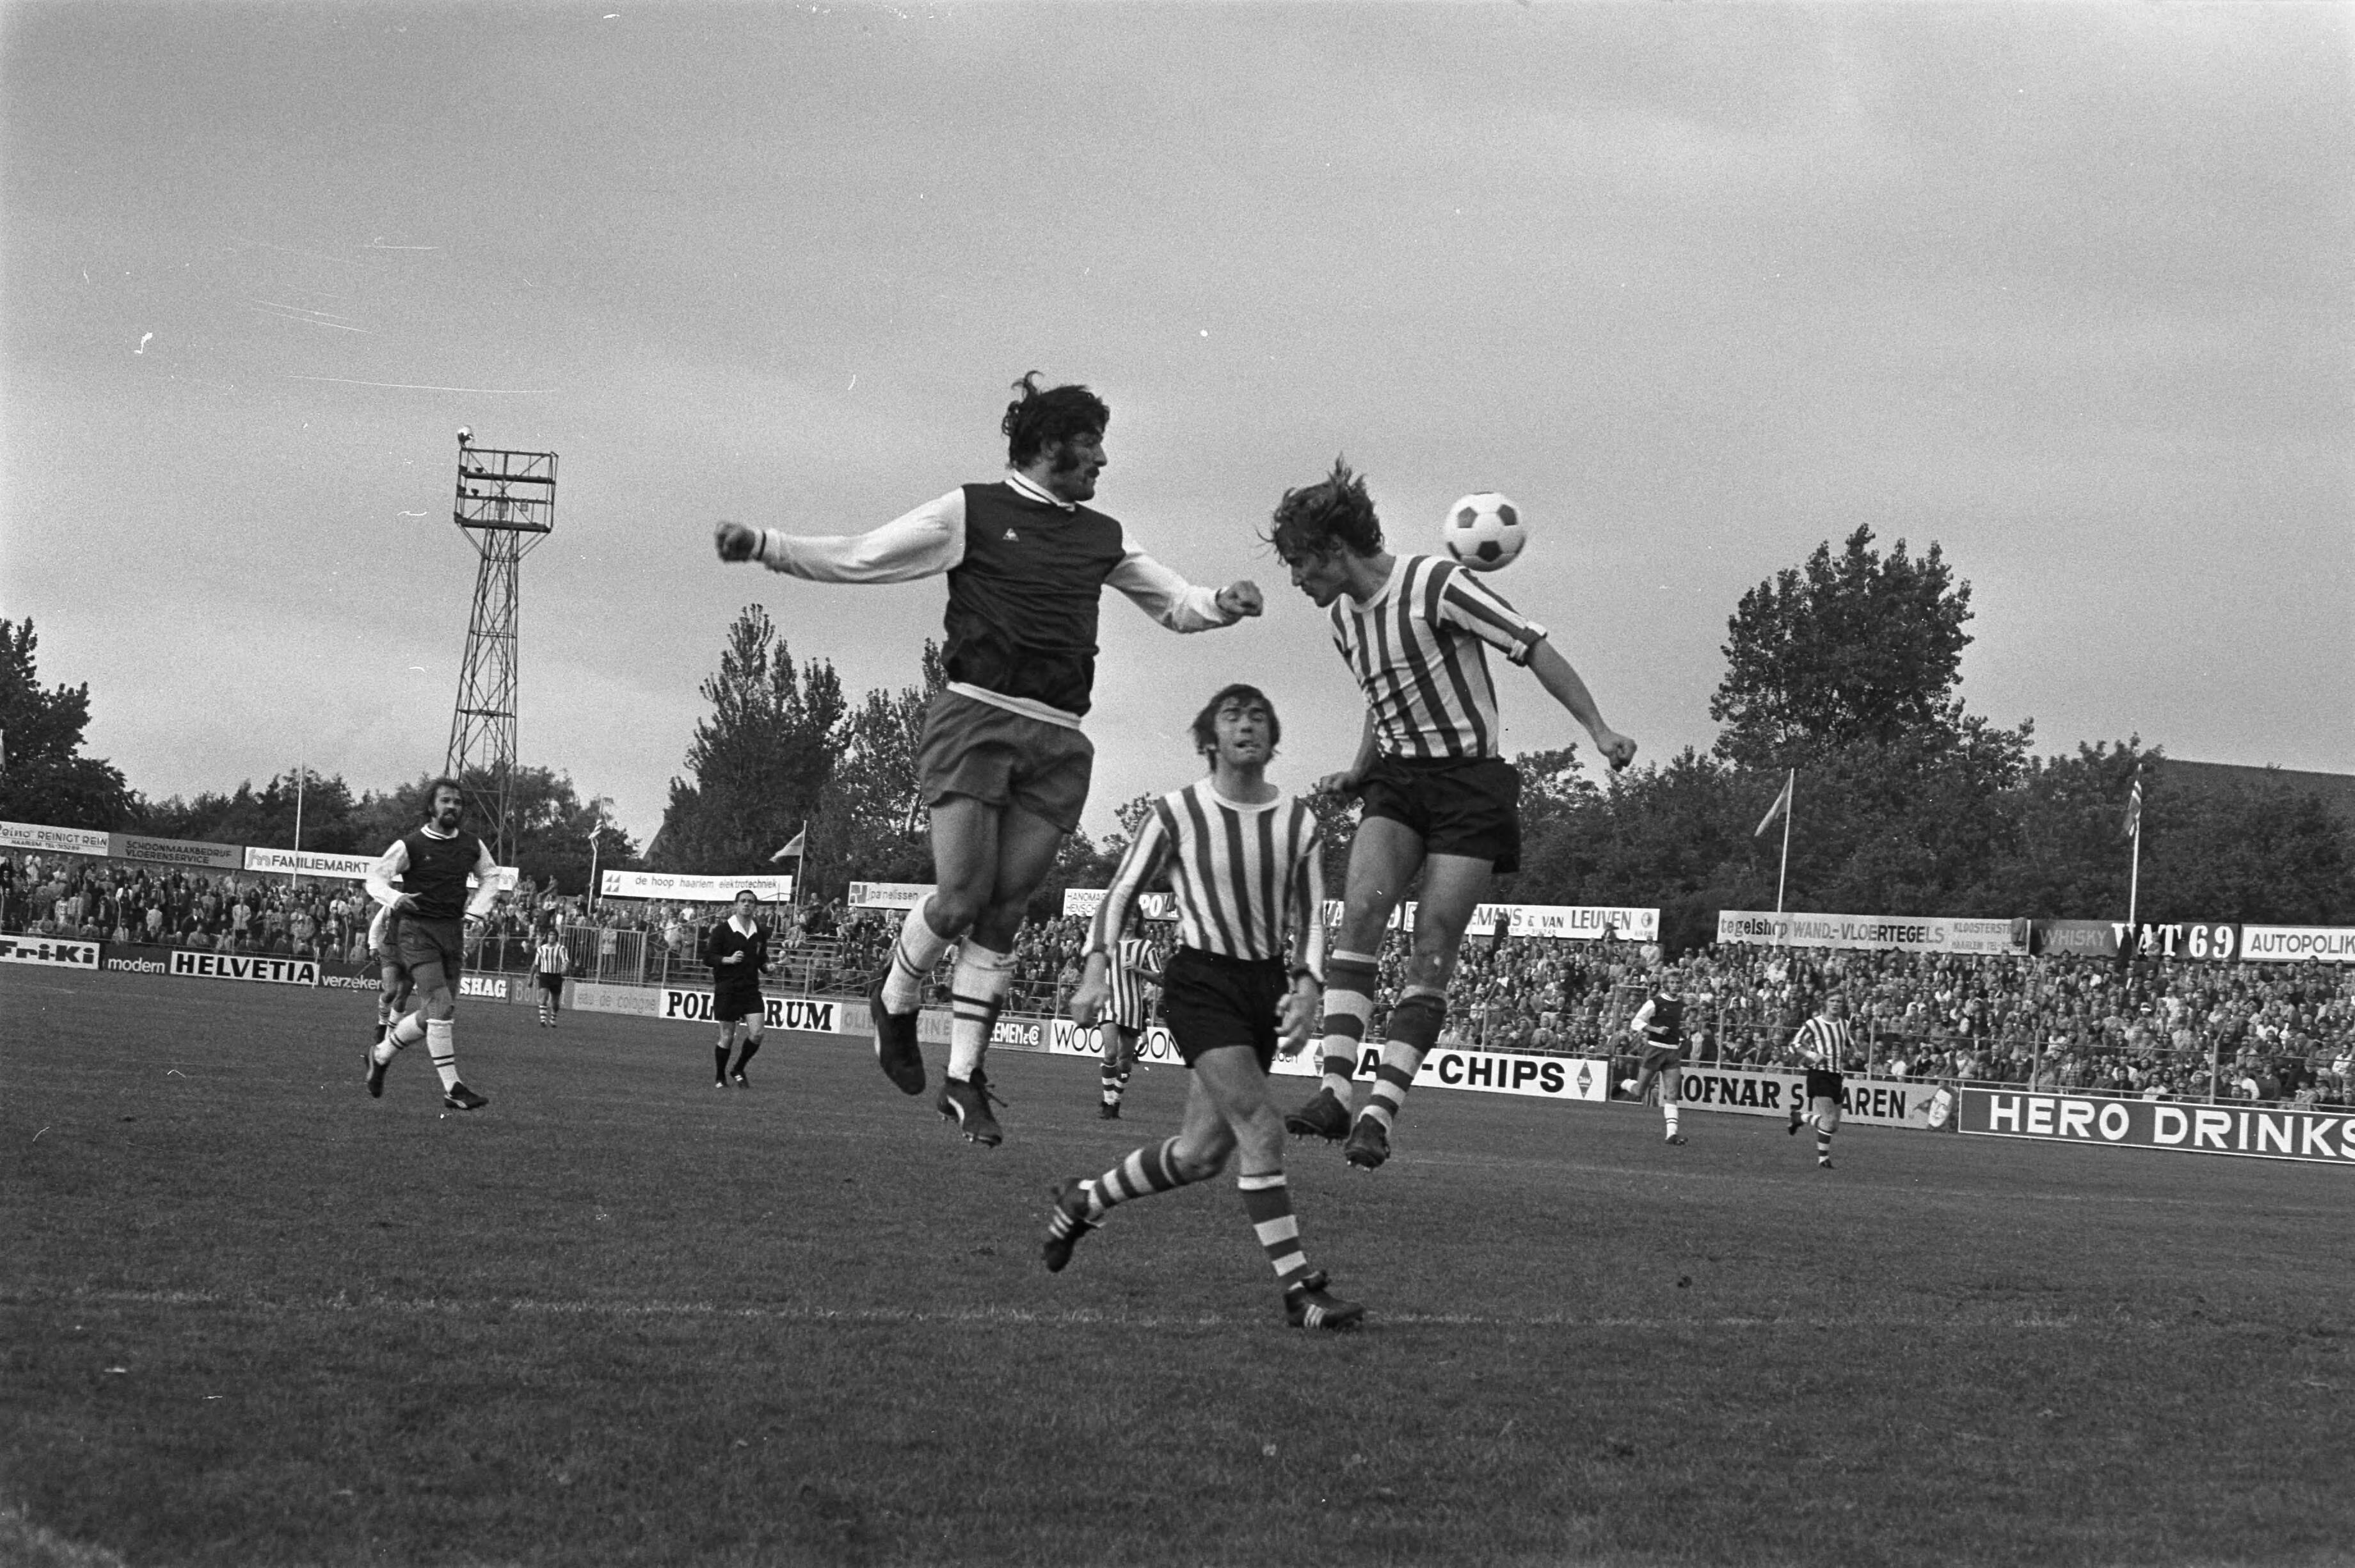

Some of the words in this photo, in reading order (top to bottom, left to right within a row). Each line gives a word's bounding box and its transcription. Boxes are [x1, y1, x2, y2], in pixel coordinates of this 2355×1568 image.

[37, 831, 80, 843] REINIGT
[83, 836, 107, 845] REIN
[125, 849, 209, 864] VLOERENSERVICE
[271, 854, 371, 874] FAMILIEMARKT
[635, 876, 648, 886] de
[651, 876, 674, 888] hoop
[680, 877, 714, 889] haarlem
[1542, 915, 1564, 929] VAN
[1571, 909, 1632, 931] LEUVEN
[2039, 929, 2107, 946] WHISKY
[108, 957, 166, 973] modern
[176, 953, 314, 983] HELVETIA
[322, 974, 385, 990] verzeker
[459, 977, 507, 998] SHAG
[1990, 1095, 2130, 1140] HERO
